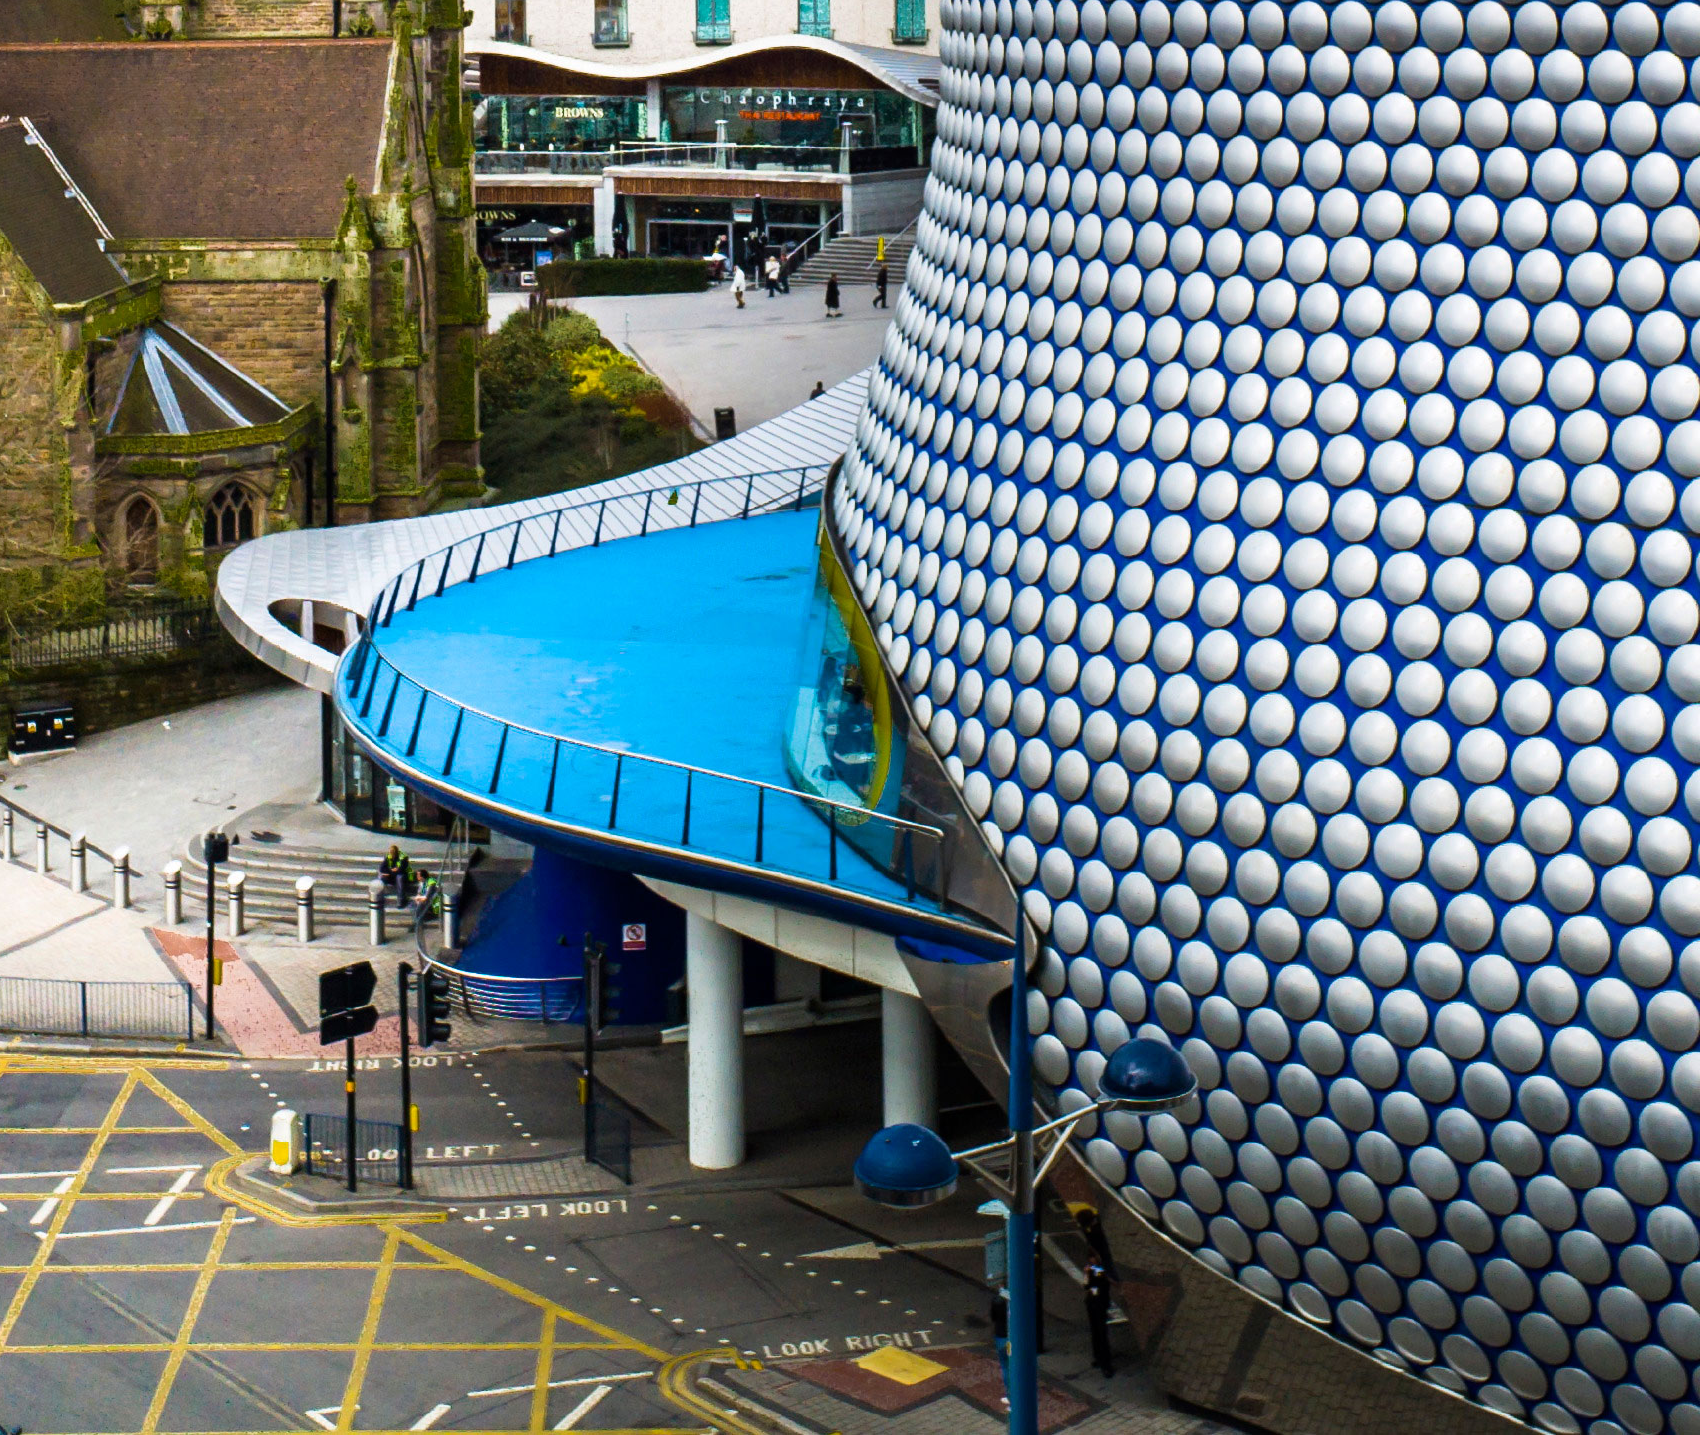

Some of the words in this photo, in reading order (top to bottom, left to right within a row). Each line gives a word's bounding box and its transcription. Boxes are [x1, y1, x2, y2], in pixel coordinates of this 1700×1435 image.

[700, 90, 864, 111] Chaophraya
[555, 107, 604, 118] BROWNS
[425, 1144, 501, 1160] LEFT
[472, 1203, 549, 1221] LEFT
[559, 1199, 628, 1217] LOOK
[762, 1338, 831, 1359] LOOK
[844, 1329, 933, 1351] RIGHT
